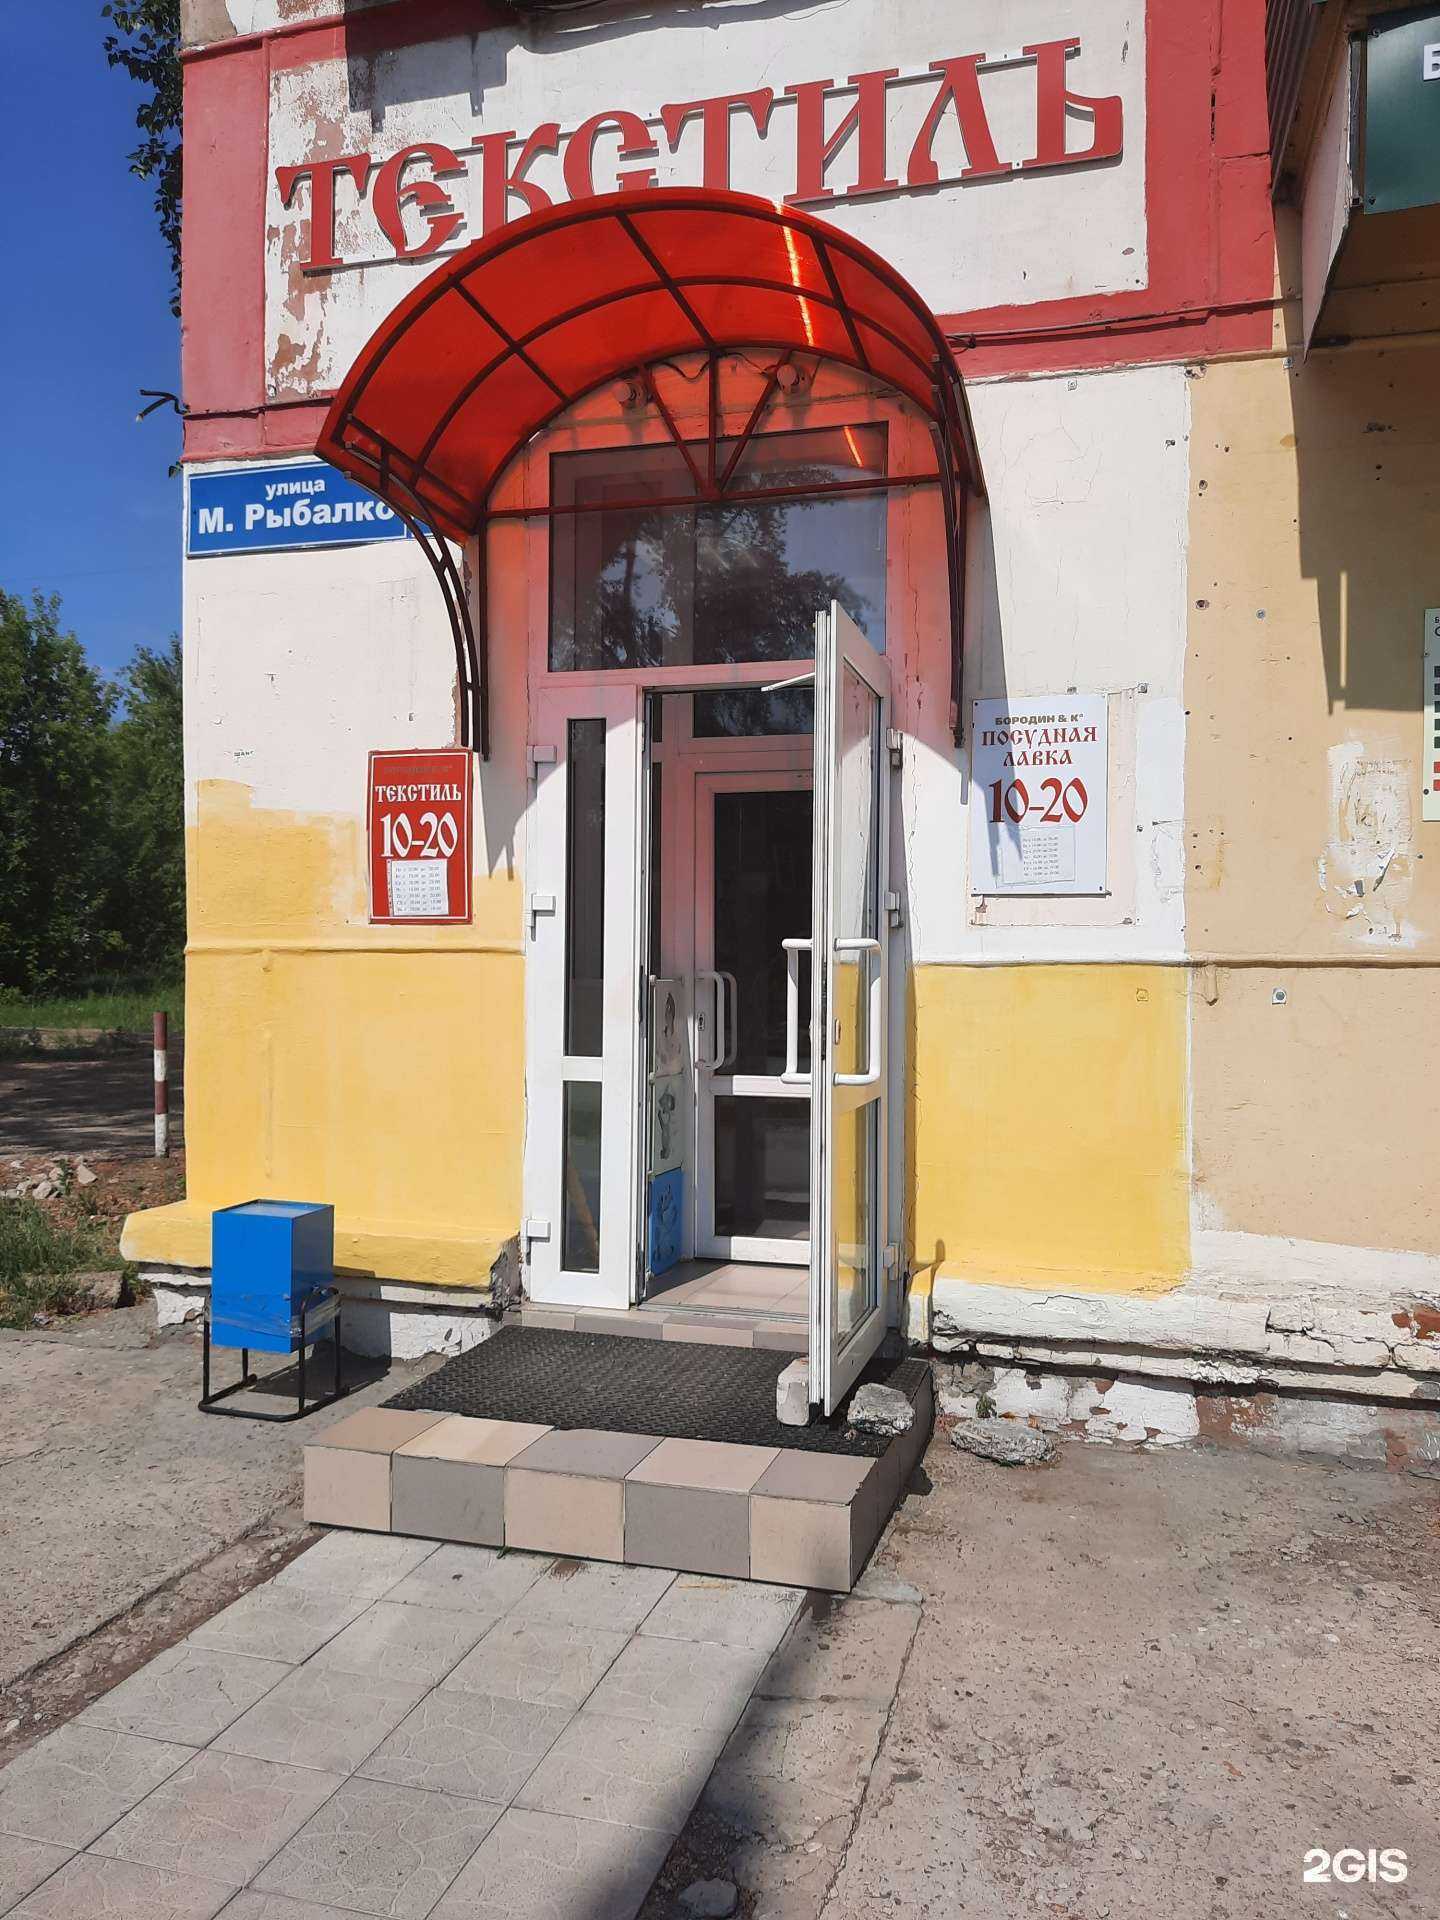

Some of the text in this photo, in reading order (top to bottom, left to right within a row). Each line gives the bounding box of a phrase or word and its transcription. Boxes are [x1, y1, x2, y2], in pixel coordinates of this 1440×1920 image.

[275, 36, 1124, 269] ТЕКСТИЛЬ
[265, 479, 325, 501] улица
[198, 498, 395, 534] М. Рыбалко
[994, 714, 1055, 726] БОРОДИН
[981, 726, 1098, 750] ПОСУДНАЯ
[1003, 749, 1074, 767] ЛАВКА
[375, 783, 462, 803] ТЕКСТИЛЬ
[988, 777, 1089, 824] 10-20
[379, 811, 459, 858] 10-20
